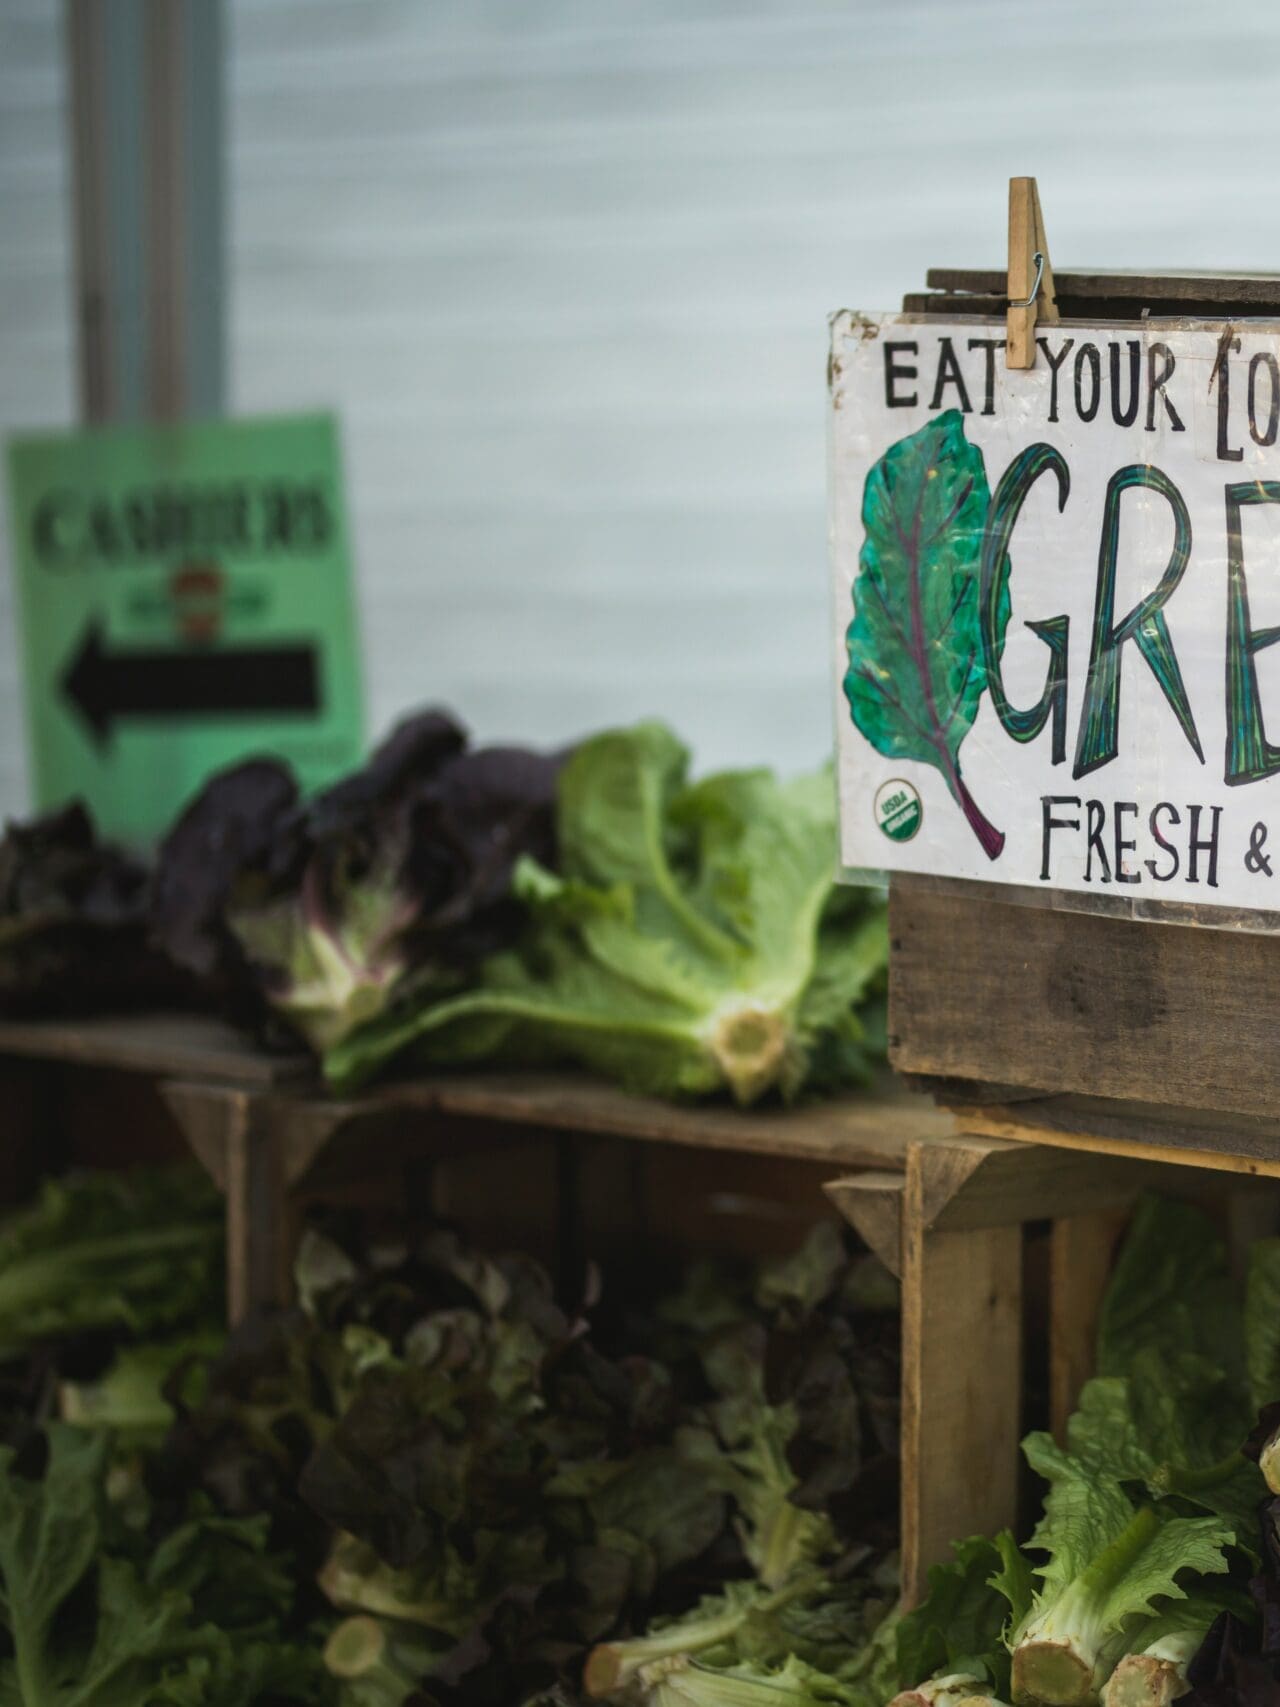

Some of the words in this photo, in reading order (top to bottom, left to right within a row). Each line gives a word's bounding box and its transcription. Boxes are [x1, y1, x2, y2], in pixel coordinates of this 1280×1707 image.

[884, 337, 1007, 416] EAT
[1036, 337, 1186, 432] YOUR
[880, 790, 908, 816] USDA
[1039, 795, 1224, 887] FRESH
[1243, 821, 1274, 878] &
